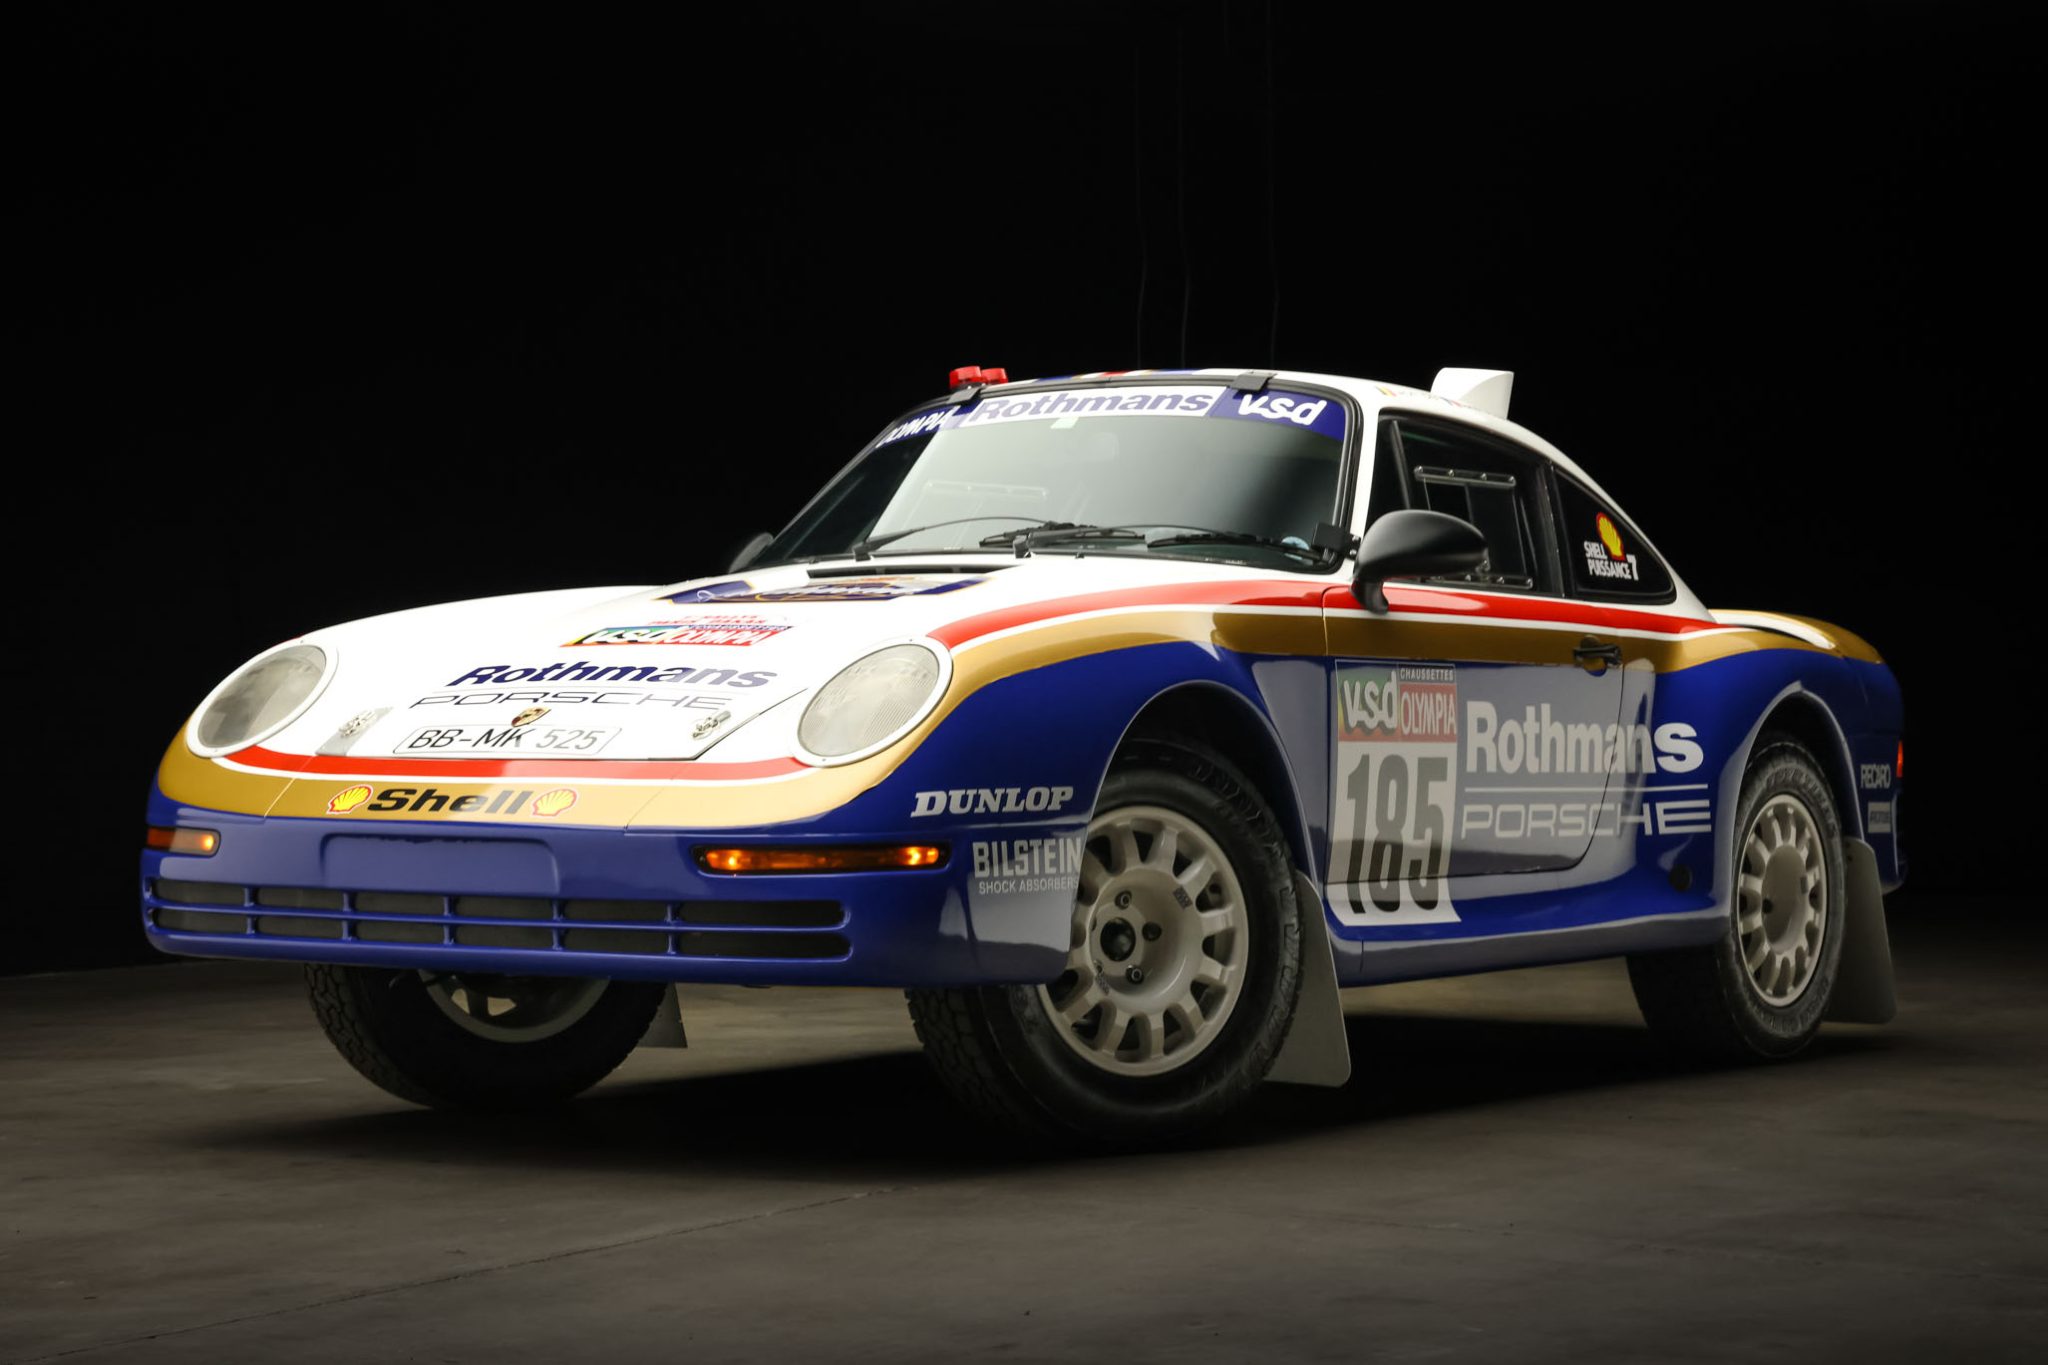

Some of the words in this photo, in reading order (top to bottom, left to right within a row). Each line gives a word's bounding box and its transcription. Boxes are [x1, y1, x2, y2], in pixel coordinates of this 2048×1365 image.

[970, 392, 1213, 421] Rothmans
[1238, 393, 1327, 426] vsd
[1583, 541, 1608, 560] SHELL
[1587, 558, 1632, 579] PUISSANCE
[1626, 553, 1639, 581] 7
[444, 661, 779, 688] Rothmans
[408, 690, 733, 711] PORSCHE
[1343, 669, 1398, 729] vsd
[1400, 691, 1458, 736] OLYMPIA
[406, 727, 537, 751] BB-MK
[535, 727, 609, 751] 525
[1465, 701, 1704, 775] Rothmans
[1860, 764, 1892, 789] RECARO
[367, 788, 535, 815] Shell
[910, 785, 1074, 818] DUNLOP
[1346, 753, 1449, 915] 185
[1460, 799, 1712, 840] PORSCHE
[972, 836, 1083, 879] BILSTEIN
[978, 879, 1017, 895] SHOCK
